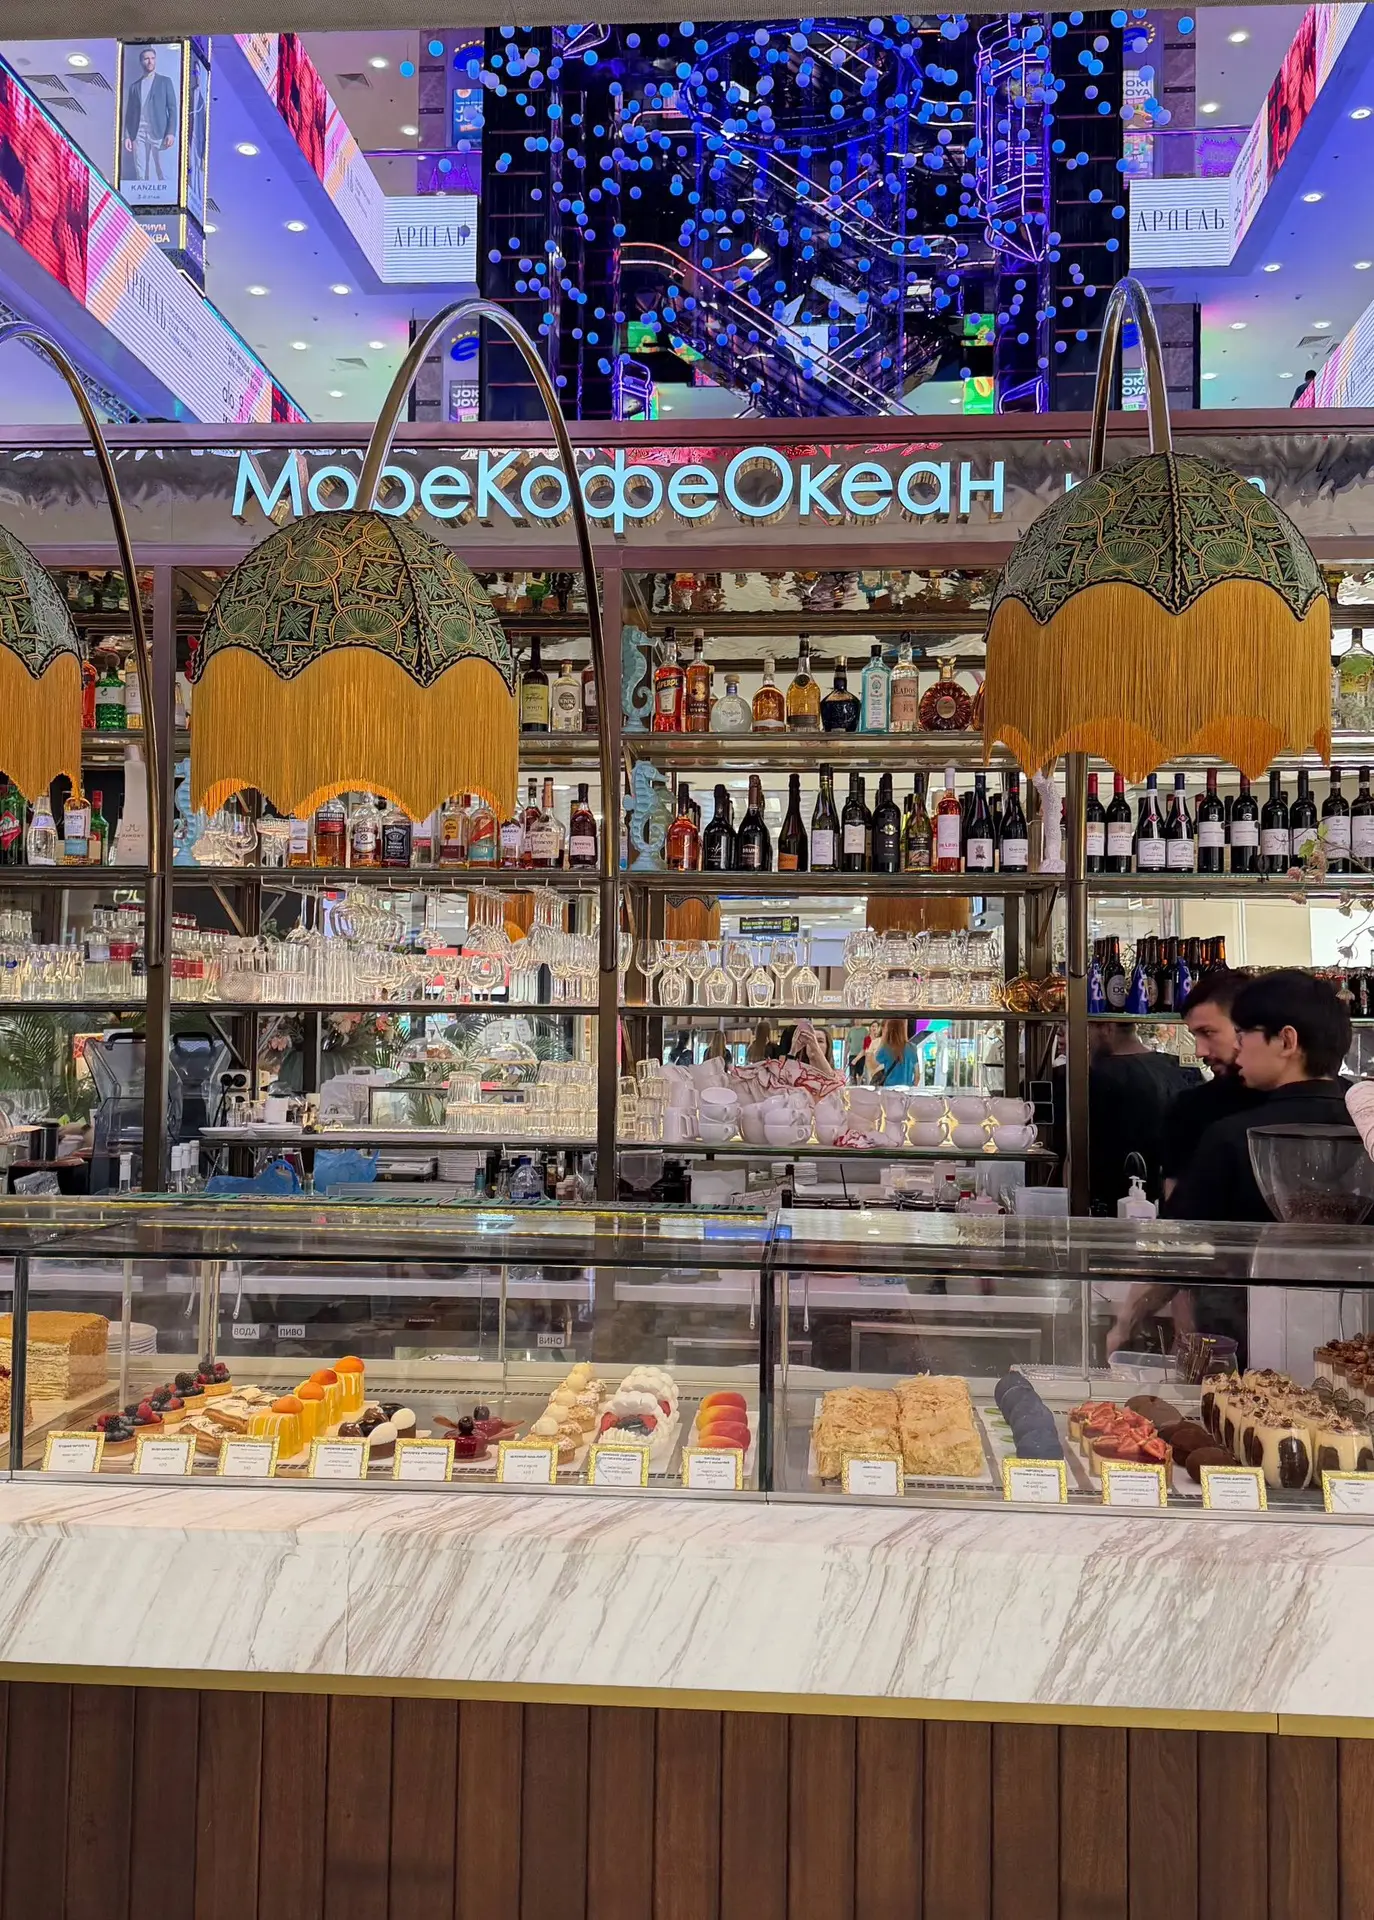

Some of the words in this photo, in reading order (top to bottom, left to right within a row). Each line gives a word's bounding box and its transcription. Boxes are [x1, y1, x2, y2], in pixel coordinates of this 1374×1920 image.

[131, 184, 168, 192] KANZLER
[453, 399, 479, 407] JOY
[233, 1327, 257, 1336] ВОДА
[280, 1328, 303, 1337] ПИВО
[538, 1337, 563, 1345] ВИНО
